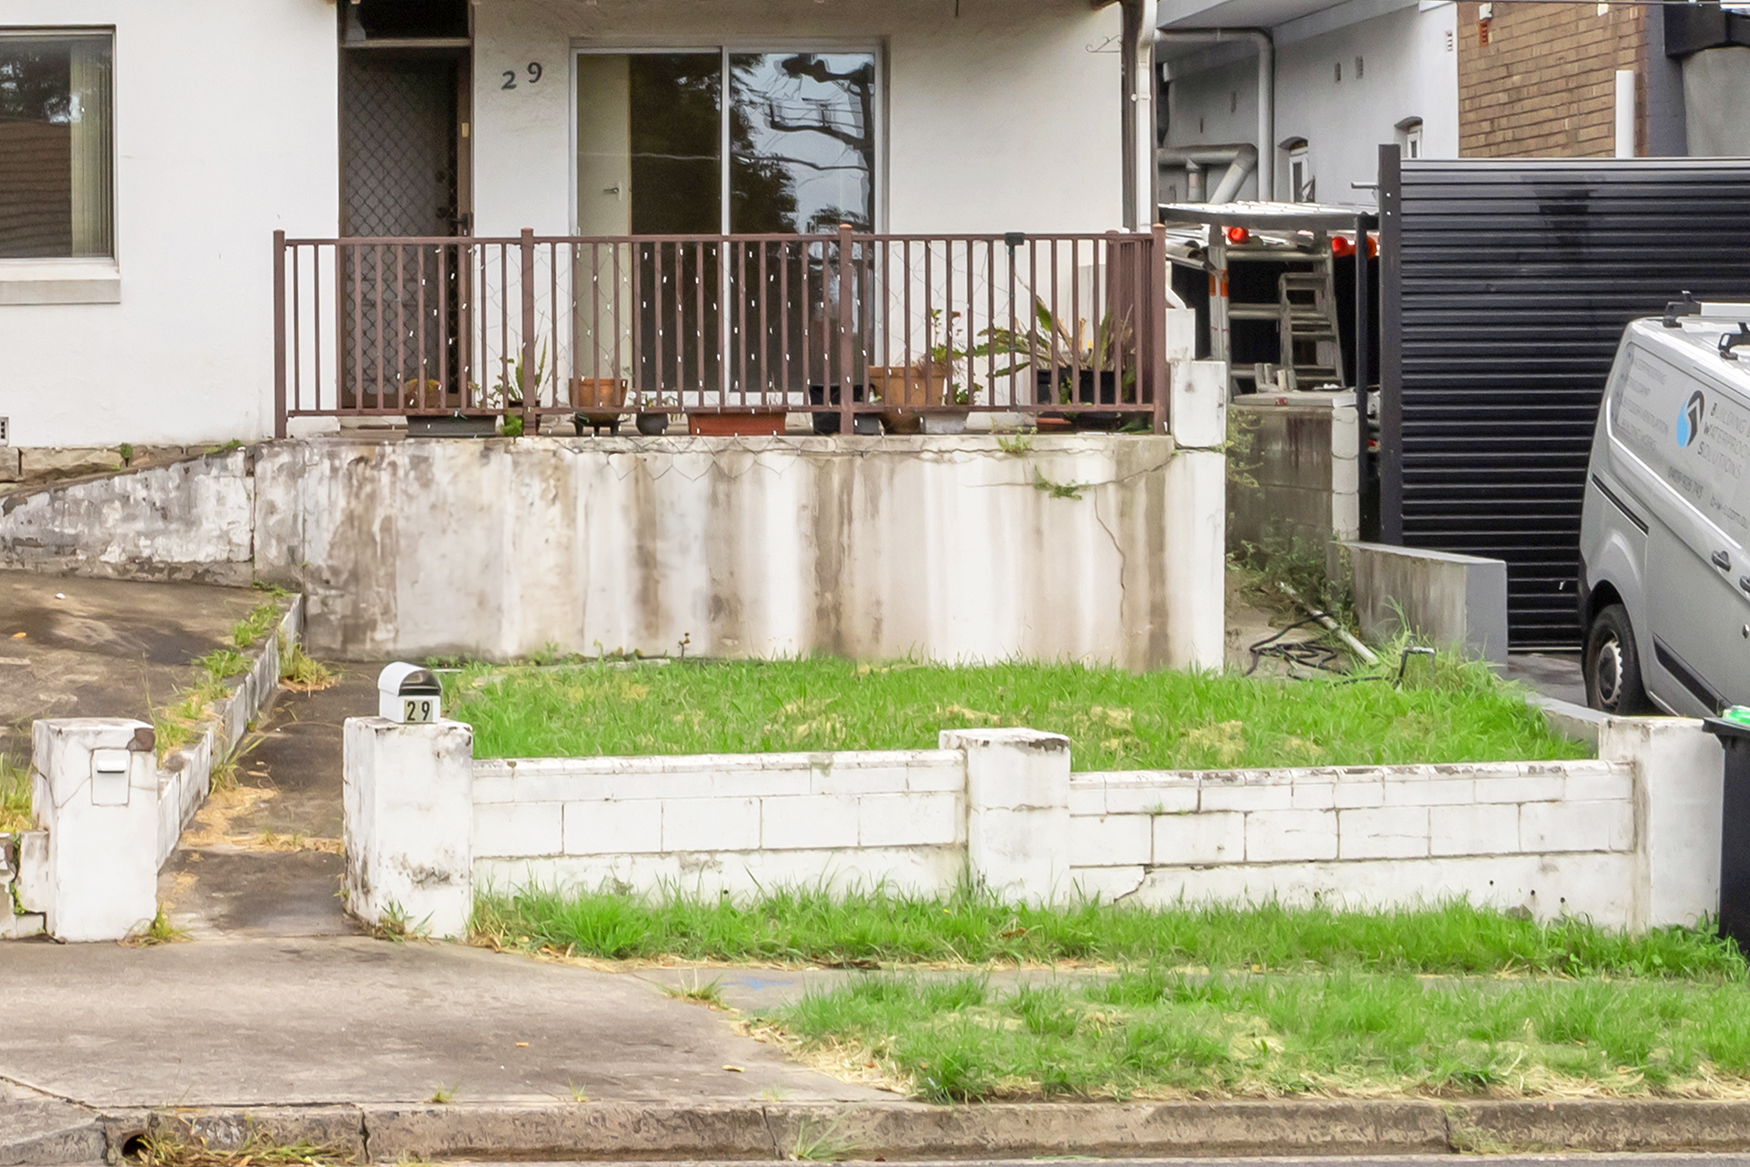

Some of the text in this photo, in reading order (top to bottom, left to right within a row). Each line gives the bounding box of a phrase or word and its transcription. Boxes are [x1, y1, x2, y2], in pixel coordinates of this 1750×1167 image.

[500, 61, 544, 91] 29
[1703, 420, 1750, 461] WATERPROO
[406, 700, 431, 722] 29
